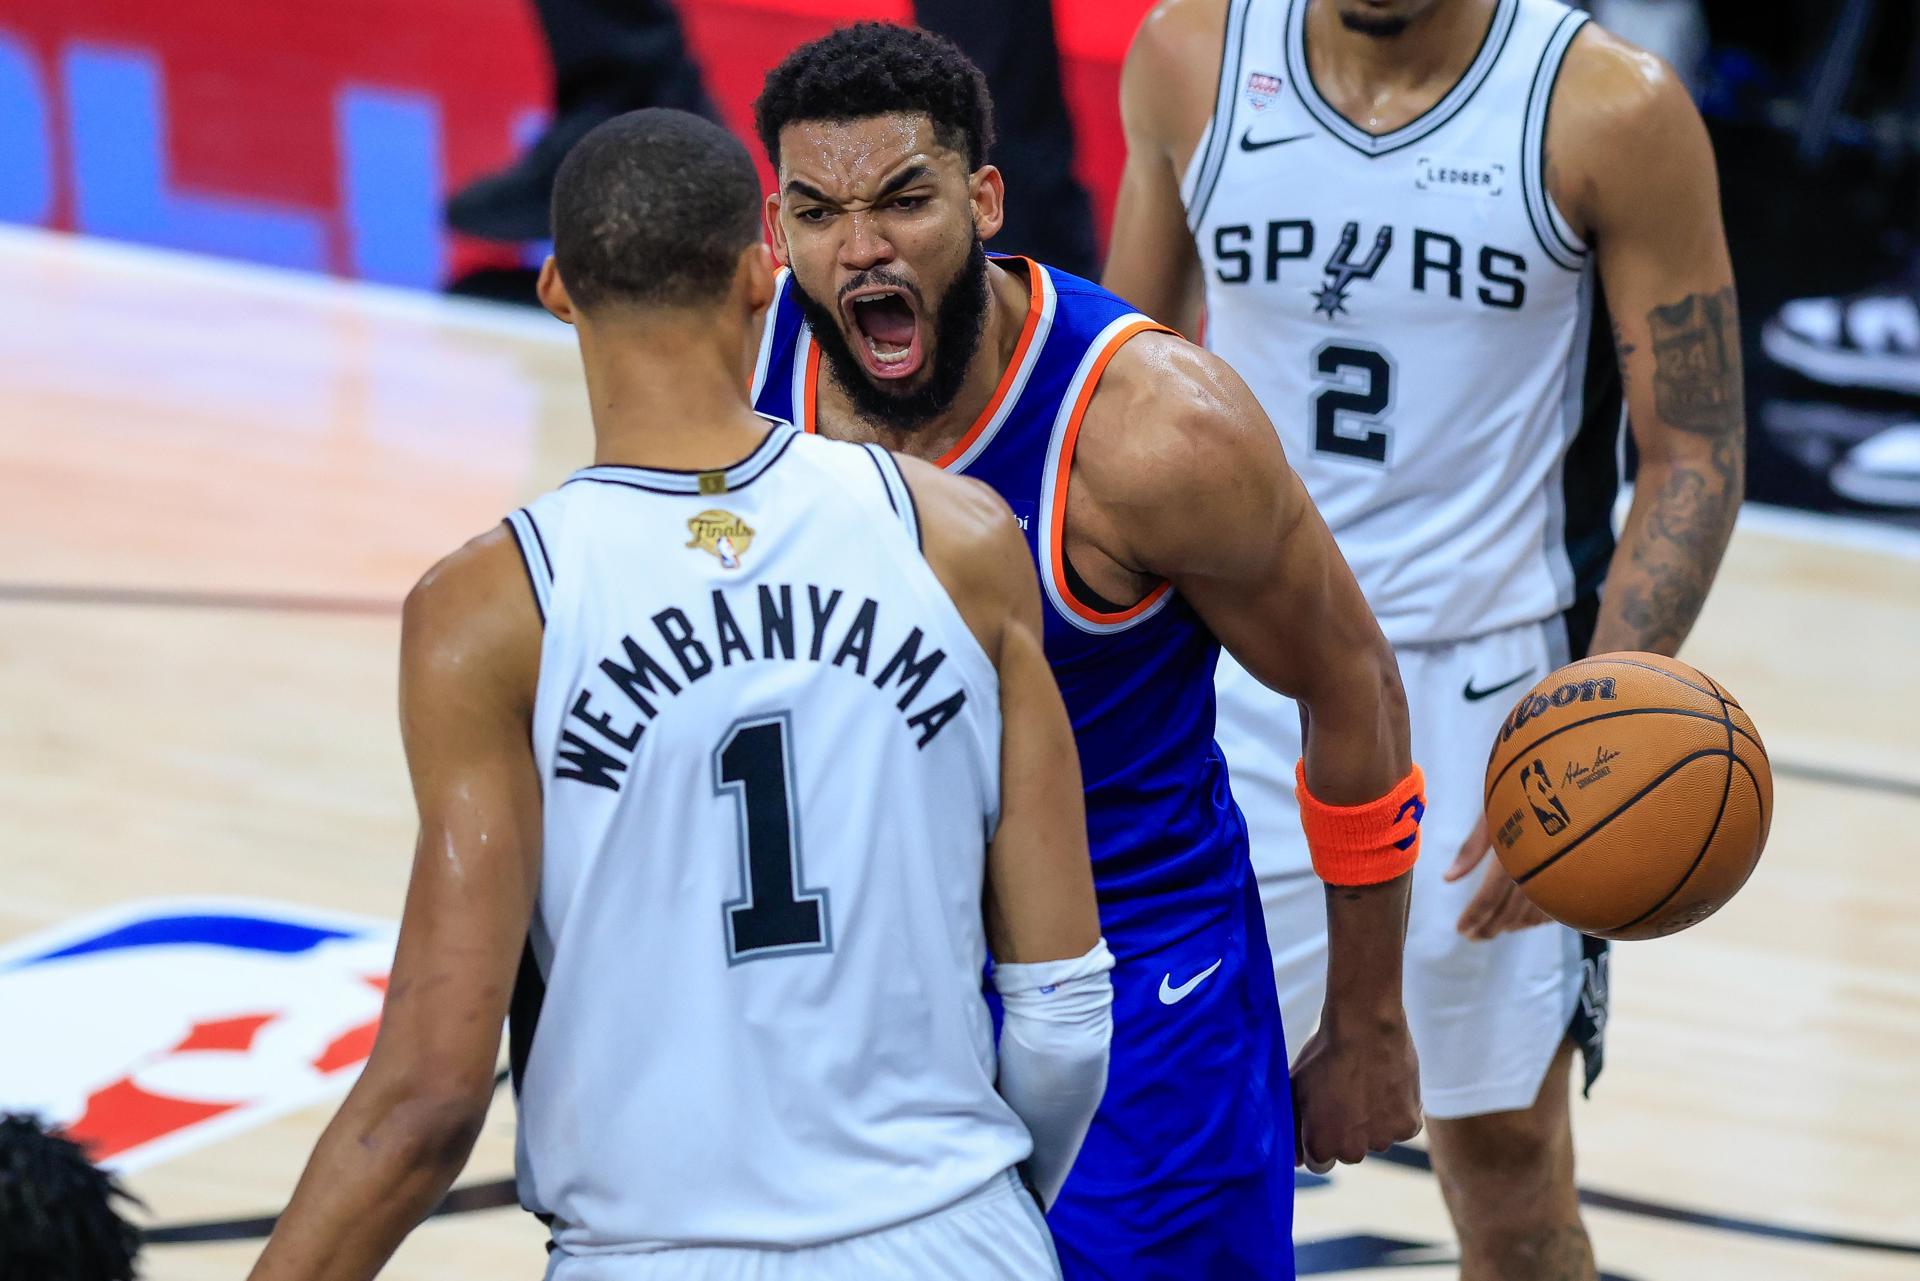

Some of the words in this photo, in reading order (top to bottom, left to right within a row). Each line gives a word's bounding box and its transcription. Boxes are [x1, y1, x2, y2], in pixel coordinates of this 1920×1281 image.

[1427, 167, 1491, 186] LEDGER
[1214, 219, 1528, 321] SPURS
[1310, 339, 1397, 468] 2
[686, 517, 755, 548] Finals
[554, 584, 968, 793] WEMBANYAMA
[1500, 677, 1617, 742] ilson
[712, 709, 834, 968] 1
